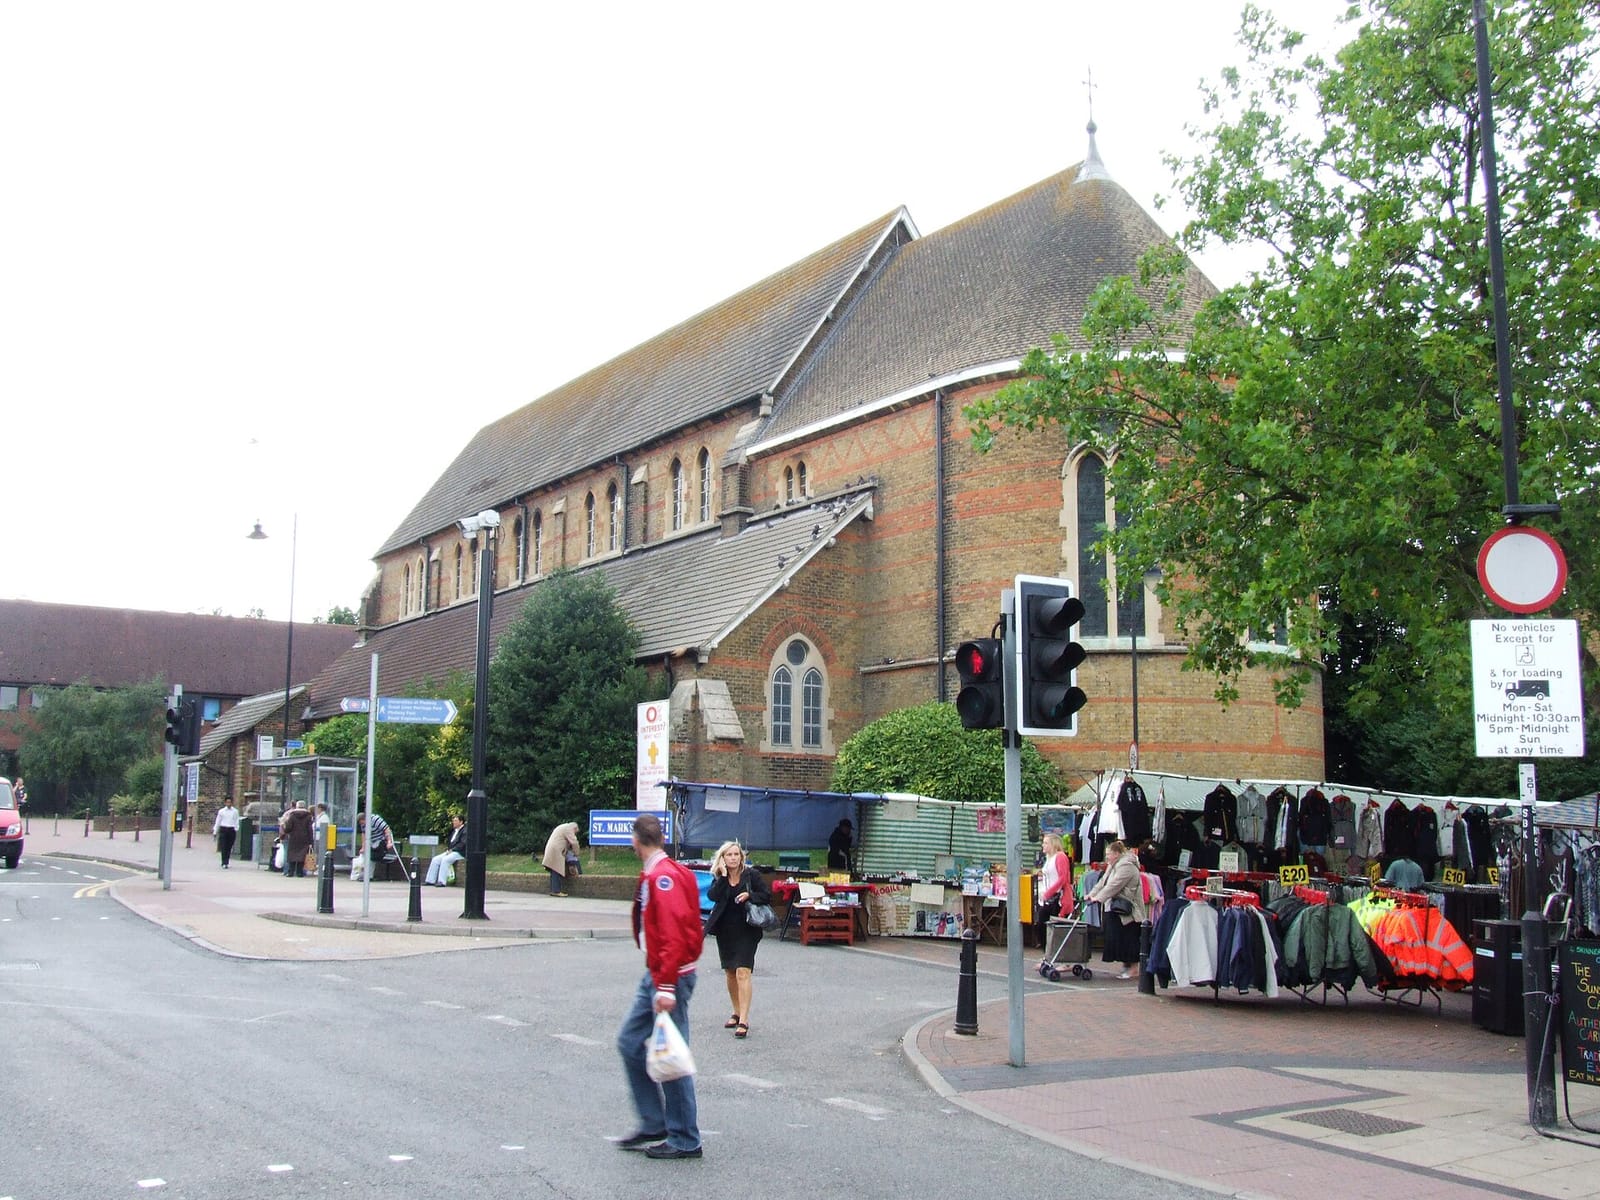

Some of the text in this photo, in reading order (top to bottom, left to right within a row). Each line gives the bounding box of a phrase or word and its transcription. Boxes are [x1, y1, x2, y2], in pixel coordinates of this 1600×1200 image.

[1491, 623, 1556, 632] No vehicles
[1495, 634, 1553, 644] Except for
[1489, 668, 1563, 679] & for loading
[1490, 680, 1503, 690] by
[1502, 703, 1526, 712] Mon
[1534, 703, 1553, 712] Sat
[1476, 713, 1524, 724] Midnight
[1489, 724, 1514, 734] 5pm
[1521, 724, 1569, 735] Midnight
[1519, 735, 1541, 743] Sun
[1497, 745, 1564, 756] at any time
[592, 822, 605, 833] ST.
[1282, 867, 1307, 882] £20
[1445, 869, 1463, 883] £10
[1571, 961, 1591, 978] THE
